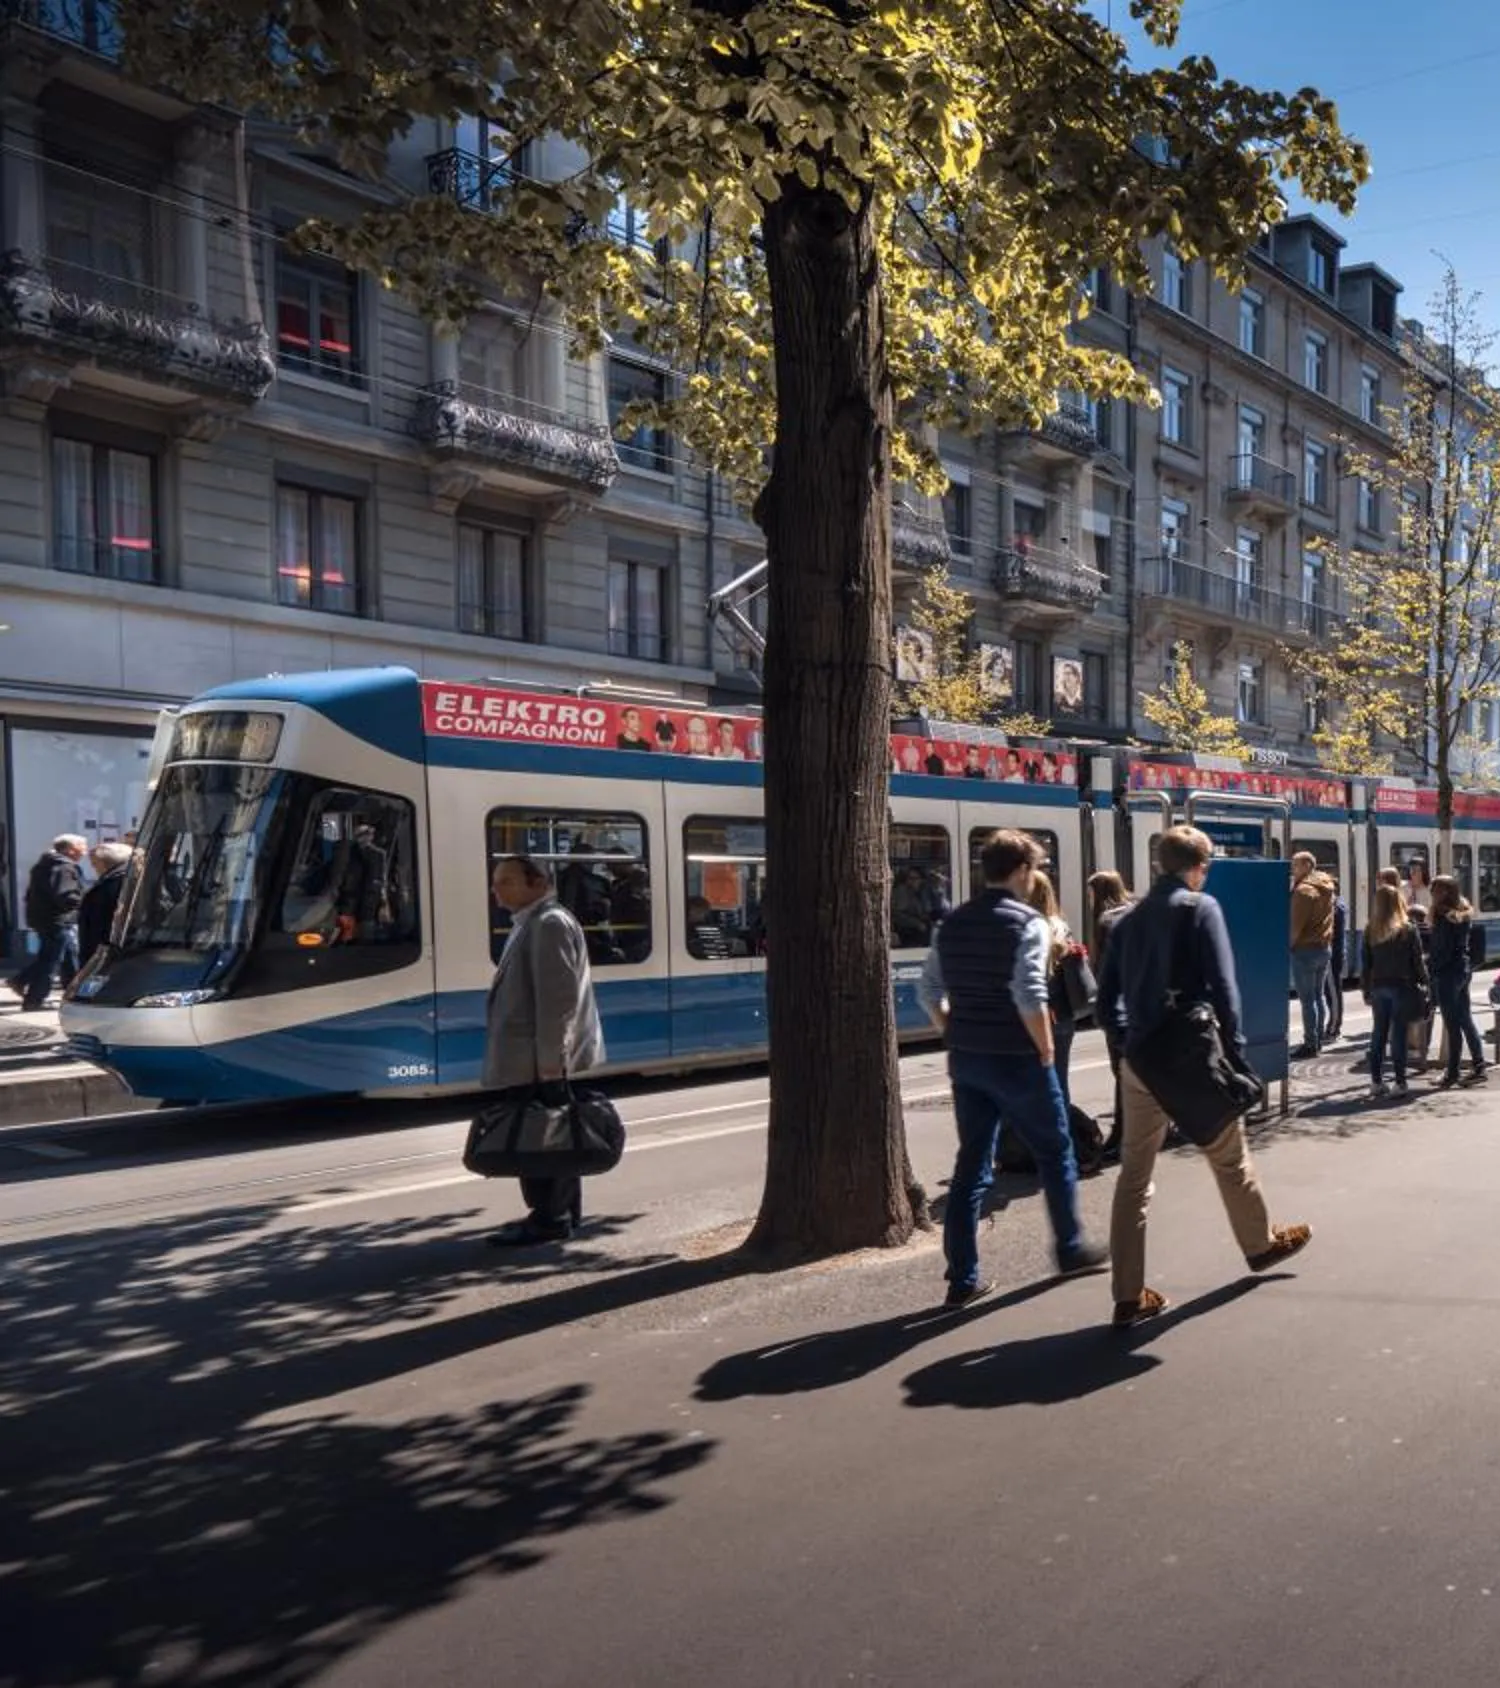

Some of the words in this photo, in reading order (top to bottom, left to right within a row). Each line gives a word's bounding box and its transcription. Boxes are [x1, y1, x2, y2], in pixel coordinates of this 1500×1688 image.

[435, 692, 607, 726] ELEKTRO
[436, 715, 607, 743] COMPAGNONI
[1249, 747, 1289, 767] TISSOT
